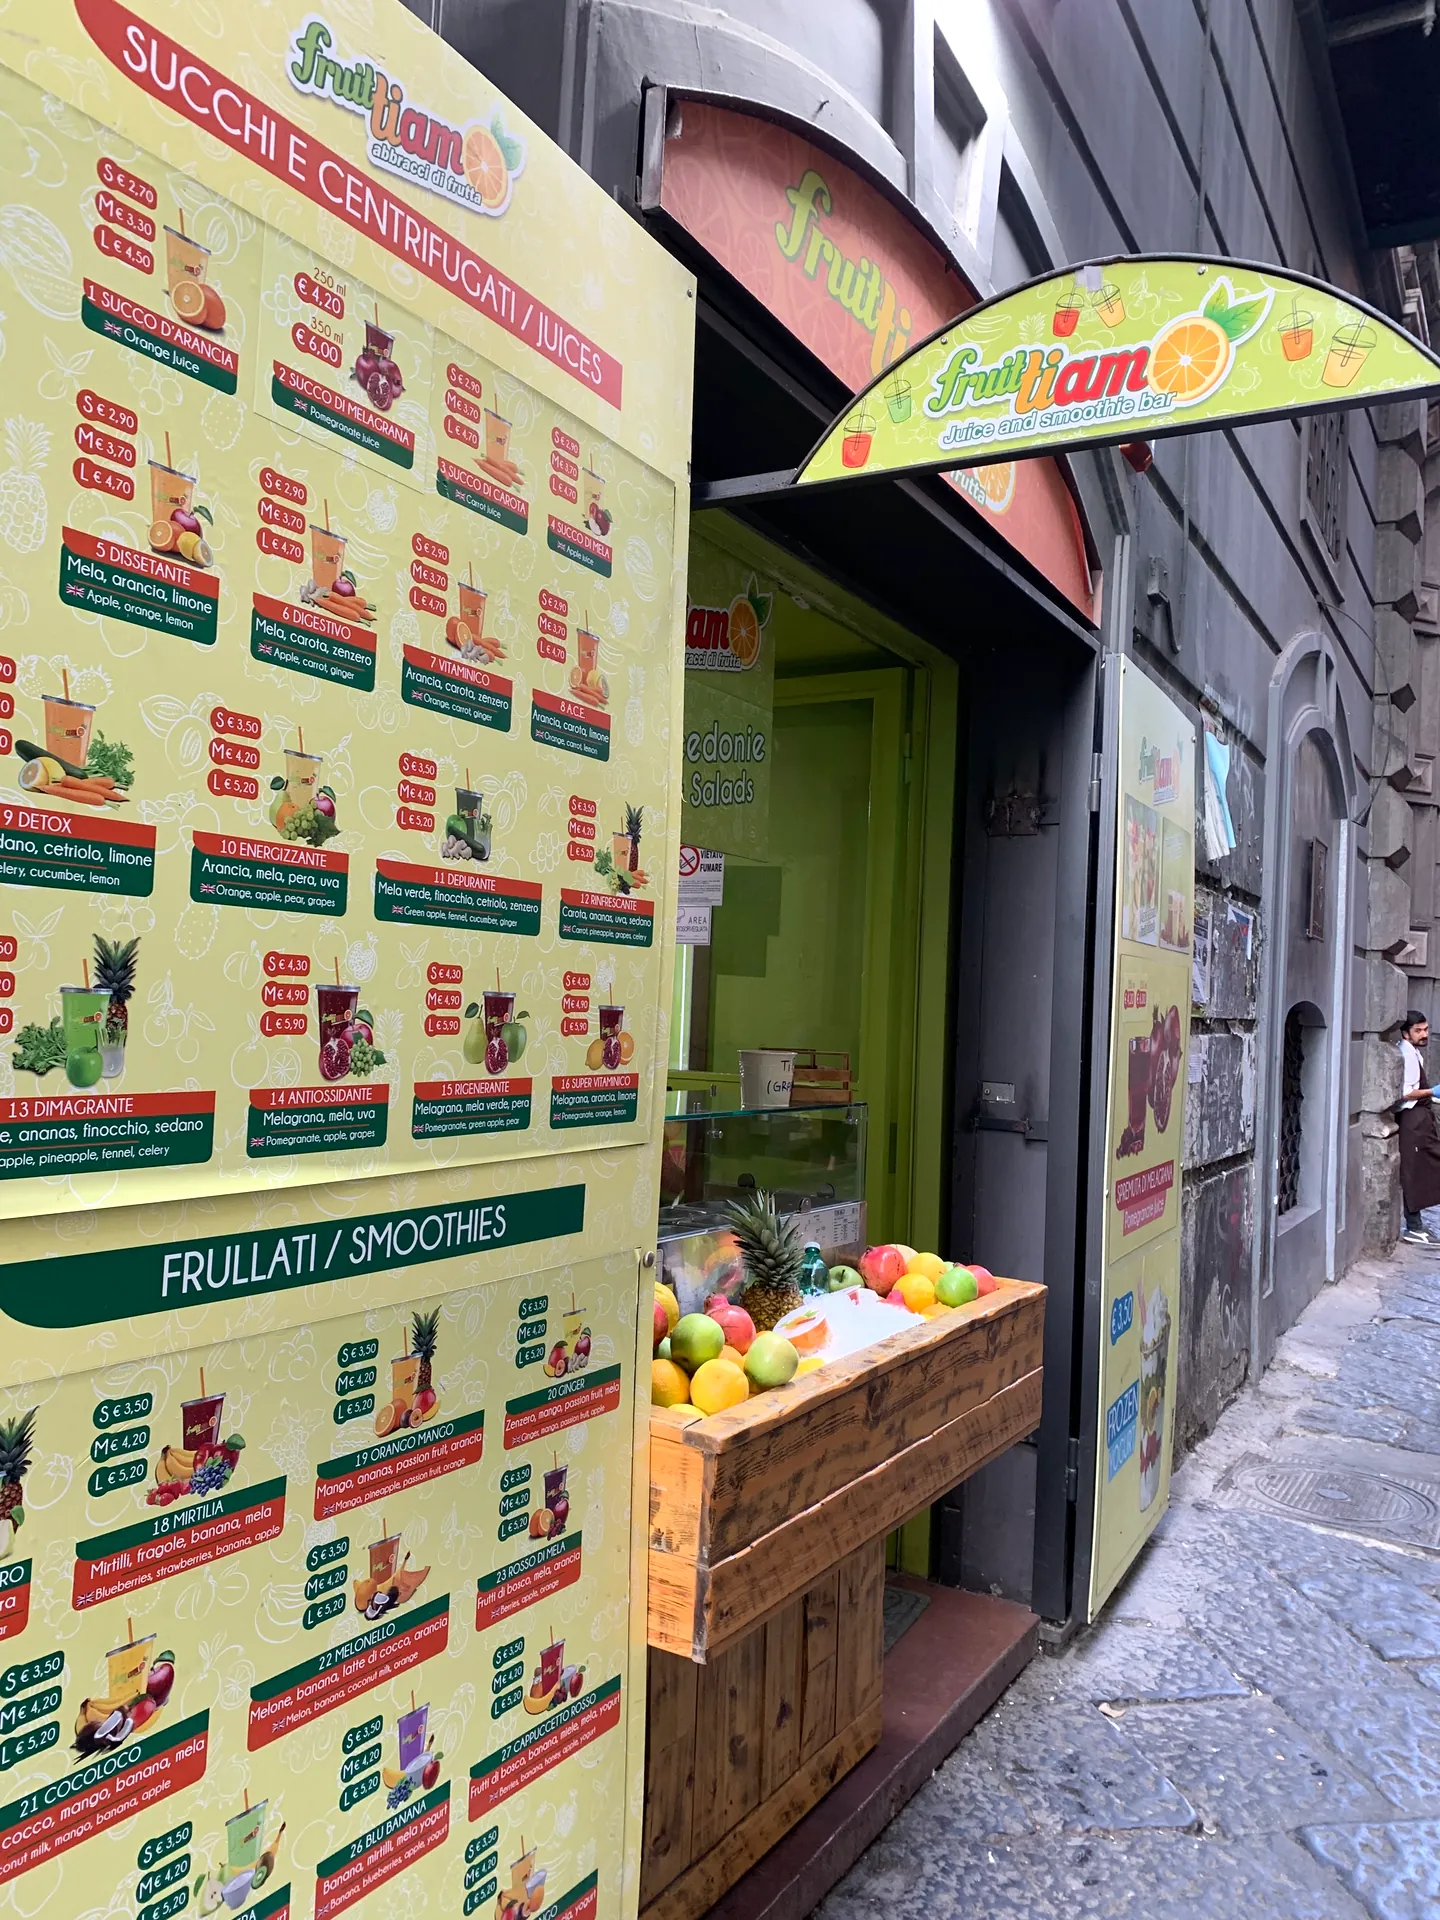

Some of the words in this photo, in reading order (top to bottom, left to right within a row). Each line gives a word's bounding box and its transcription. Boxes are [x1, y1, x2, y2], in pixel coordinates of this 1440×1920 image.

[291, 21, 464, 176] fruittiam
[371, 144, 430, 181] abbracci
[430, 165, 445, 187] di
[446, 171, 483, 206] frutta
[123, 25, 276, 161] SUCCHI
[288, 133, 307, 182] E
[318, 160, 516, 325] CENTRIFUGATI
[520, 304, 534, 331] /
[536, 312, 602, 385] JUICES
[297, 278, 307, 295] €
[312, 286, 341, 314] 4,20
[313, 267, 334, 288] 250
[336, 285, 347, 297] ml
[88, 285, 96, 302] 1
[101, 291, 157, 329] SUCCO
[161, 319, 234, 370] D'ARANCIA
[124, 327, 170, 360] Orange
[295, 328, 305, 345] €
[309, 338, 338, 363] 6,00
[311, 316, 331, 337] 350
[334, 333, 344, 345] ml
[928, 347, 1149, 414] fruittiam
[278, 367, 286, 382] 2
[289, 373, 332, 405] SUCCO
[334, 395, 346, 412] DI
[347, 404, 409, 446] MELAGRANA
[310, 406, 361, 439] Pomegranate
[943, 421, 994, 444] Juice
[998, 413, 1036, 435] and
[1040, 397, 1134, 428] smoothie
[1138, 391, 1176, 411] bar
[440, 460, 446, 474] 3
[449, 464, 481, 490] SUCCO
[483, 484, 492, 497] DI
[493, 489, 526, 515] CAROTA
[466, 495, 486, 511] Carrot
[551, 519, 556, 530] 4
[557, 523, 584, 545] SUCCO
[585, 536, 592, 548] DI
[592, 542, 610, 559] MELA
[96, 542, 106, 559] 5
[110, 548, 191, 586] DISSETANTE
[67, 556, 107, 584] Mela,
[112, 573, 168, 602] arancia,
[172, 589, 212, 614] limone
[86, 590, 121, 610] Apple,
[124, 602, 163, 623] orange,
[165, 613, 194, 630] lemon
[282, 606, 290, 621] 6
[293, 610, 352, 640] DIGESTIVO
[256, 618, 286, 640] Mela,
[290, 631, 330, 654] carota,
[332, 644, 372, 666] zenzero
[708, 652, 717, 667] di
[718, 651, 741, 669] frutta
[273, 647, 301, 665] Apple,
[302, 657, 329, 674] carrot,
[331, 665, 355, 680] ginger
[430, 656, 436, 668] 7
[439, 659, 490, 686] VITAMINICO
[405, 667, 443, 689] Arancia,
[445, 682, 476, 700] carota,
[478, 693, 509, 710] zenzero
[690, 769, 754, 807] Salads
[3, 809, 13, 826] 9
[18, 812, 72, 834] DETOX
[44, 841, 104, 863] cetriolo,
[109, 847, 153, 867] limone
[220, 839, 237, 855] 10
[240, 845, 327, 868] ENERGIZZANTE
[202, 858, 252, 879] Arancia,
[256, 867, 285, 883] mela,
[288, 872, 317, 887] pera,
[320, 876, 340, 889] uva
[433, 871, 445, 884] 11
[447, 873, 496, 892] DEPURANTE
[688, 916, 707, 924] AREA
[270, 1091, 285, 1106] 14
[287, 1087, 372, 1104] ANTIOSSIDANTE
[441, 1084, 453, 1096] 15
[455, 1081, 509, 1095] RIGENERANTE
[561, 1079, 570, 1089] 16
[572, 1077, 593, 1089] SUPER
[593, 1076, 631, 1087] VITAMINICO
[8, 1101, 29, 1118] 13
[34, 1097, 134, 1117] DIMAGRANTE
[263, 1110, 326, 1127] Melagrana,
[328, 1109, 355, 1123] mela,
[357, 1109, 375, 1120] uva
[19, 1126, 79, 1142] ananas,
[83, 1121, 151, 1139] finocchio,
[155, 1117, 203, 1133] sedano
[161, 1234, 316, 1298] FRULLATI
[324, 1229, 341, 1269] /
[349, 1204, 507, 1266] SMOOTHIES
[548, 1388, 557, 1400] 20
[558, 1378, 585, 1397] GINGER
[1108, 1383, 1139, 1443] FROZEN
[355, 1453, 368, 1468] 19
[370, 1435, 416, 1461] ORANGO
[417, 1423, 454, 1444] MANGO
[152, 1518, 169, 1536] 18
[173, 1500, 224, 1529] MIRTILIA
[90, 1556, 133, 1579] Mirtilli,
[136, 1537, 187, 1563] fragole,
[190, 1518, 242, 1544] banana,
[245, 1505, 272, 1525] mela
[95, 1572, 153, 1600] Blueberries,
[156, 1550, 213, 1578] strawberries,
[215, 1539, 252, 1556] banana,
[254, 1525, 281, 1542] apple
[496, 1572, 507, 1584] 23
[508, 1557, 536, 1578] ROSSO
[537, 1553, 545, 1565] DI
[546, 1541, 565, 1559] MELA
[318, 1655, 333, 1670] 22
[335, 1623, 395, 1661] MELONELLO
[501, 1747, 512, 1762] 27
[513, 1709, 569, 1754] CAPPUCCETTO
[570, 1693, 596, 1718] ROSSO
[19, 1797, 39, 1818] 21
[44, 1746, 142, 1805] COCOLOCO
[350, 1840, 363, 1858] 26
[365, 1826, 384, 1848] BLU
[386, 1799, 427, 1835] BANANA
